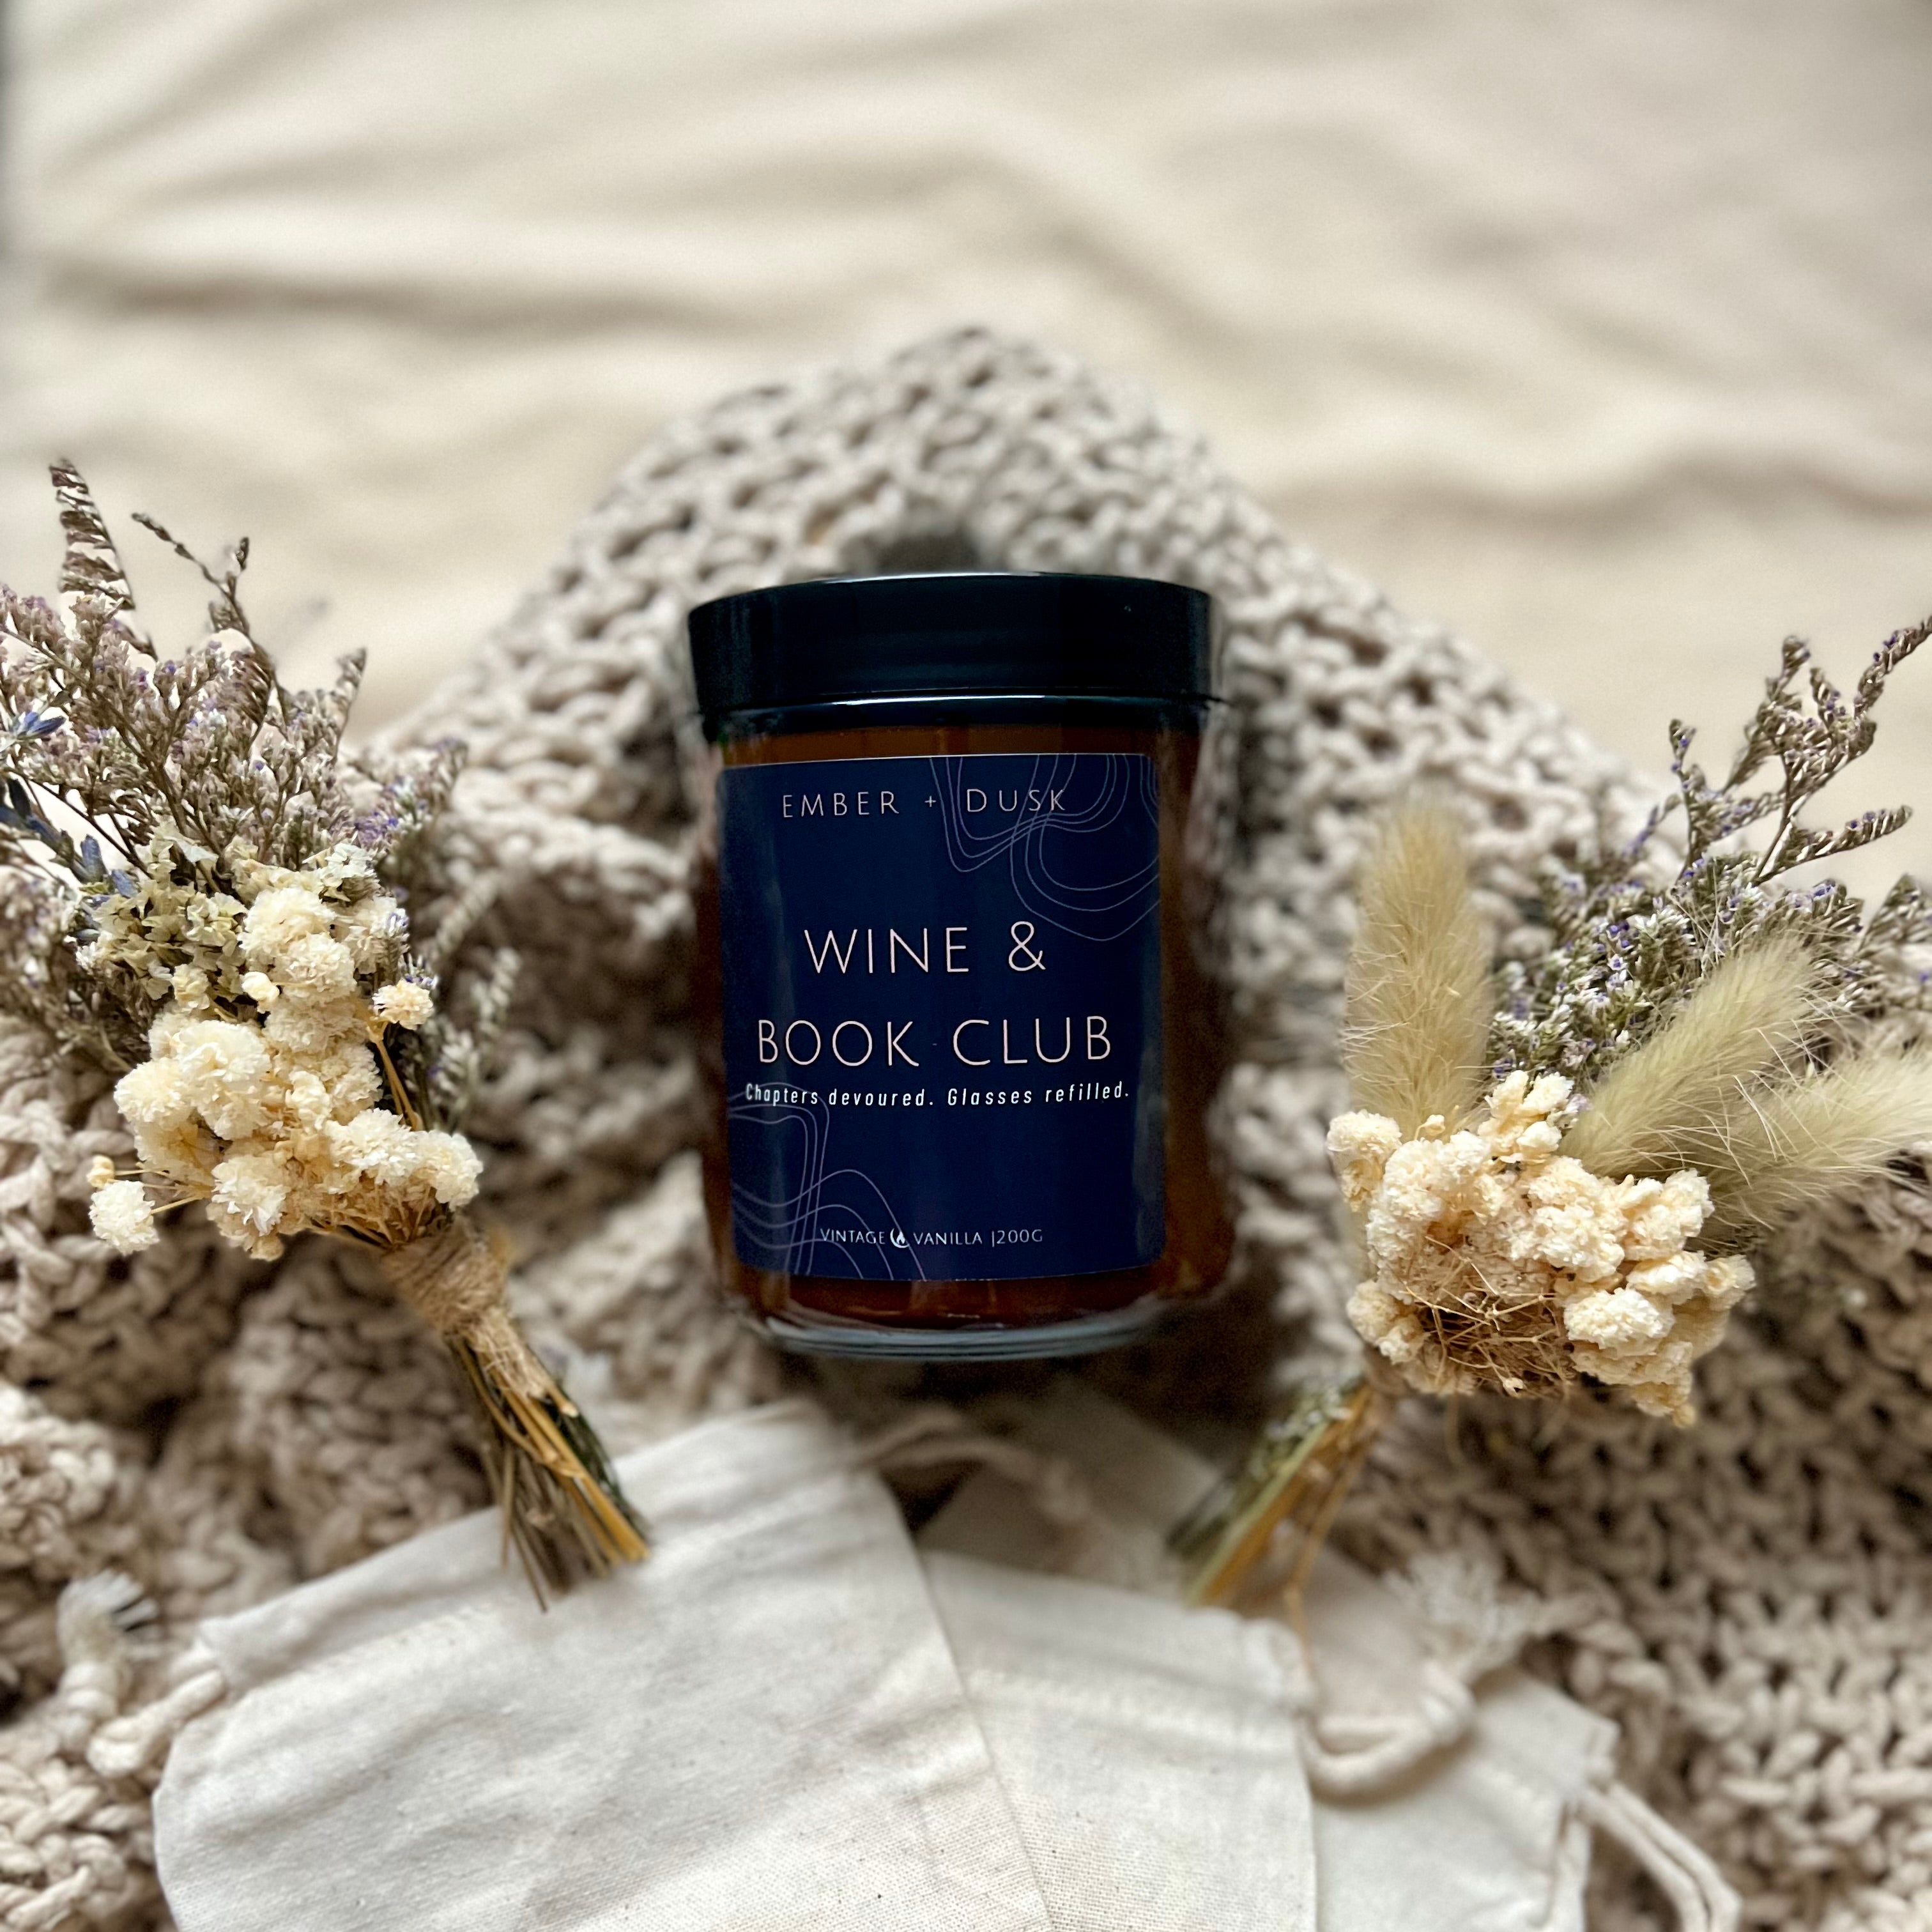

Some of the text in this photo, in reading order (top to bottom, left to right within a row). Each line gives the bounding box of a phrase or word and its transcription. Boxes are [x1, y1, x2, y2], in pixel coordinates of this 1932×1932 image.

[783, 788, 1066, 818] EMBER + DUSK
[804, 921, 1046, 974] WINE &
[758, 1016, 1112, 1066] BOOK CLUB
[745, 1081, 1130, 1108] Chapters devoured. Glasses refilled.
[820, 1228, 885, 1245] VINTAGE
[912, 1230, 983, 1245] VANILLA
